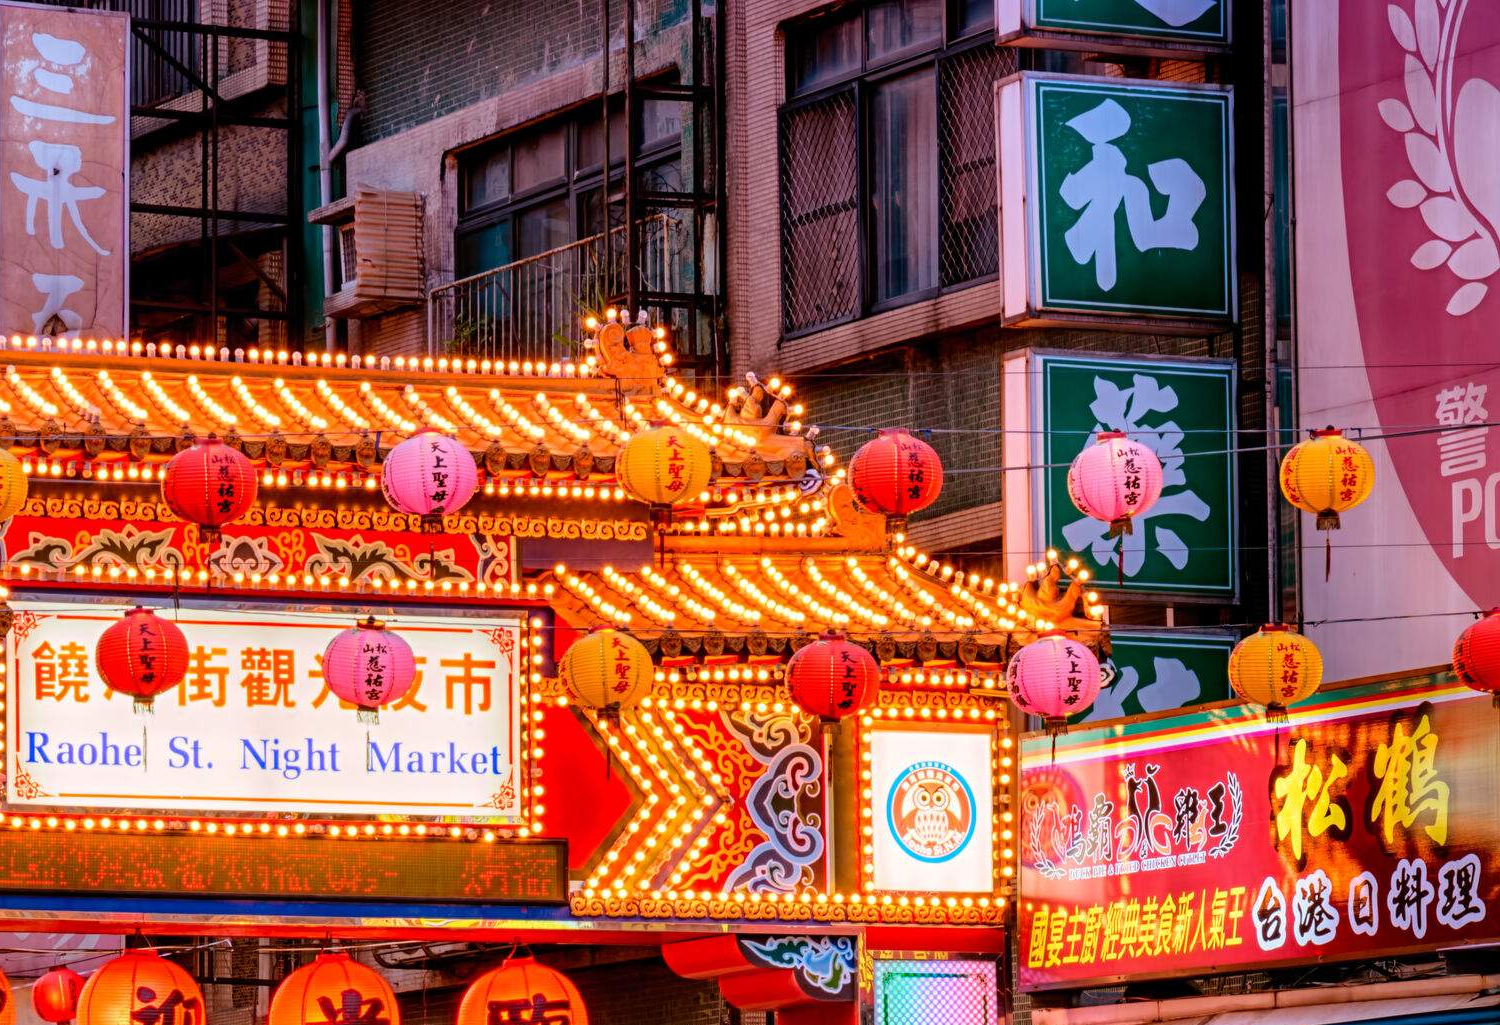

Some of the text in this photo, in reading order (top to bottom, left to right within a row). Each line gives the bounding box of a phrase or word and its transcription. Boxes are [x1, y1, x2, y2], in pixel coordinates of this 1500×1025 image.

[25, 730, 503, 780] Raohe St. Night Market
[1273, 713, 1450, 861] 松鶴
[1253, 855, 1485, 947] 台港日料理
